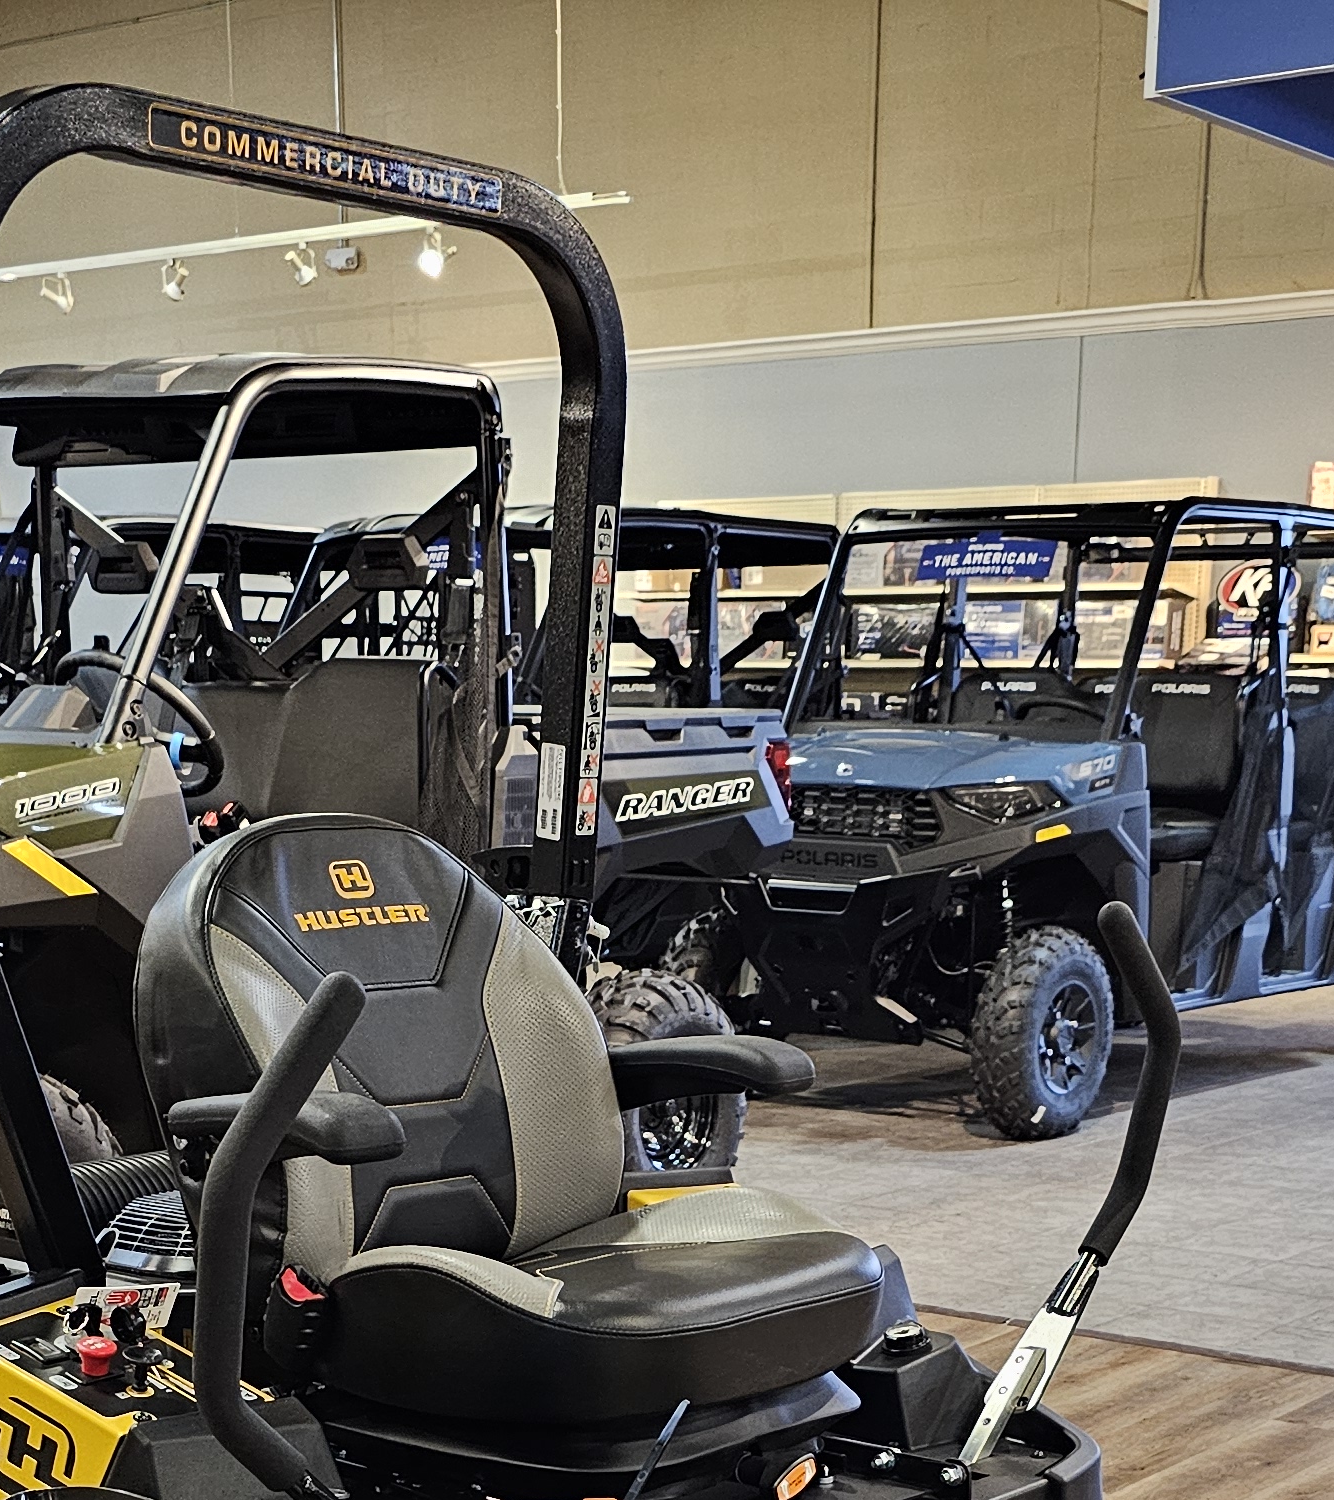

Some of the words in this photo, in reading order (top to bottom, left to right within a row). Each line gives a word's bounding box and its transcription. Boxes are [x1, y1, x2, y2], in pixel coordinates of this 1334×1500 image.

[180, 120, 393, 188] COMMERCIAL
[407, 167, 485, 204] DUTY
[934, 554, 961, 568] THE
[962, 551, 1039, 567] AMERICAN
[1228, 567, 1273, 607] KF
[611, 683, 656, 693] POLARIS
[980, 681, 1037, 692] PLARIS
[1152, 683, 1211, 695] POLARIS
[14, 777, 122, 819] 1000
[615, 776, 755, 823] RANGER
[780, 849, 879, 869] POLARIS
[294, 904, 430, 932] HUSTLER
